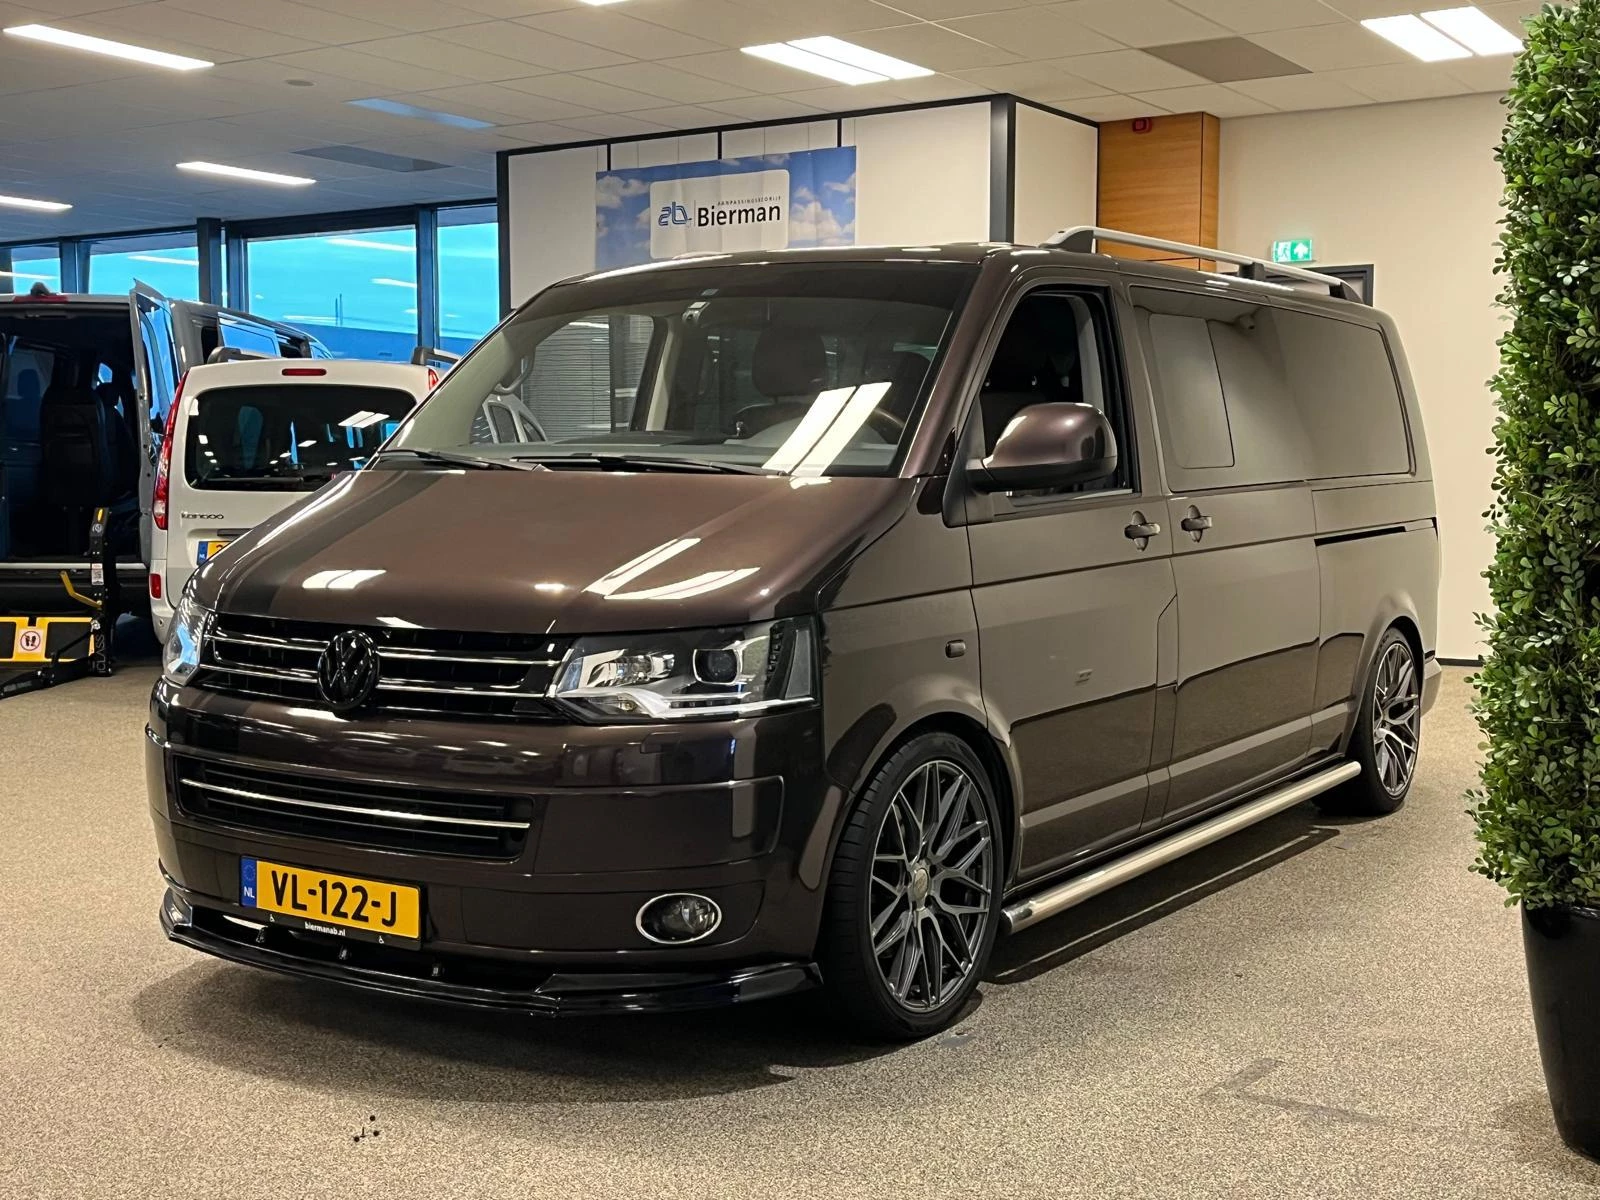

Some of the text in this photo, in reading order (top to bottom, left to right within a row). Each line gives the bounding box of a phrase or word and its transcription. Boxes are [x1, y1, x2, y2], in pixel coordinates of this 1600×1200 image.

[697, 204, 781, 227] Bierman
[243, 870, 397, 927] NL VL-122-J
[304, 921, 346, 937] biermanab.nl
